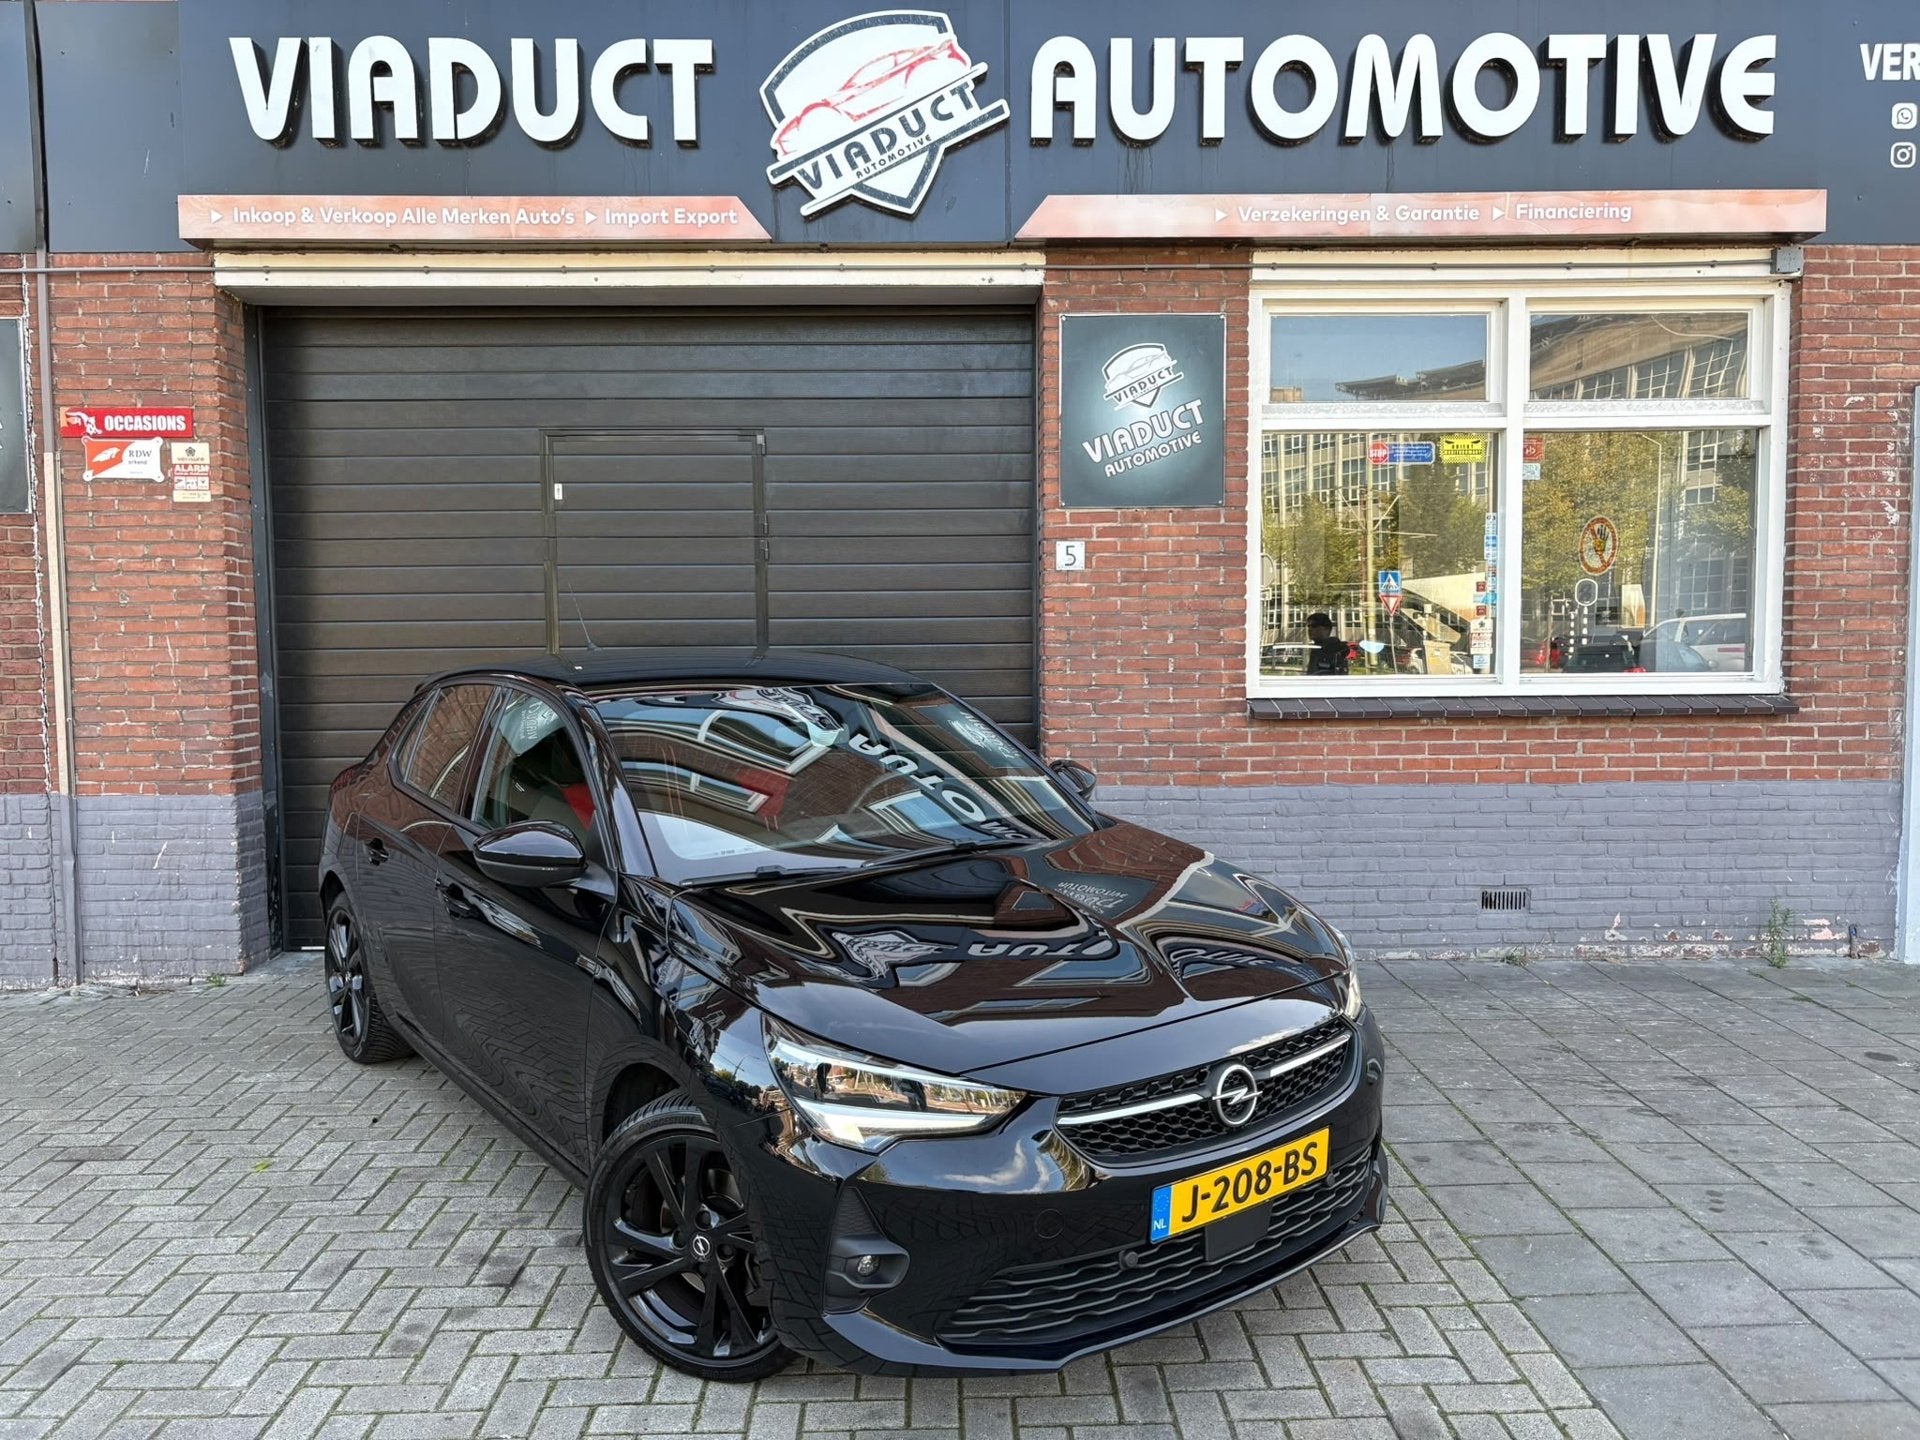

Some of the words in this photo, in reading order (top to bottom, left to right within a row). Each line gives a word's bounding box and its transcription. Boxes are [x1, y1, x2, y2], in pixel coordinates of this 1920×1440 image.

[1860, 43, 1920, 81] VER
[229, 36, 713, 142] VIADUCT
[1030, 33, 1777, 141] AUTOMOTIVE
[797, 81, 982, 190] VIADUCT
[855, 134, 932, 178] AUTOMOTIVE
[233, 207, 296, 226] Inkoop
[301, 207, 314, 223] &
[320, 208, 397, 227] Verkoop
[402, 208, 437, 224] Alle
[442, 208, 511, 224] Merken
[515, 208, 575, 225] Auto's
[605, 208, 670, 227] Import
[674, 209, 738, 227] Export
[1238, 206, 1371, 225] Verzekeringen
[1375, 205, 1390, 222] &
[1395, 205, 1480, 221] Garantie
[1516, 202, 1632, 222] Financiering
[1114, 367, 1172, 402] VIADUCT
[104, 415, 186, 431] OCCASIONS
[1082, 399, 1204, 463] VIADUCT
[1104, 430, 1202, 478] AUTOMOTIVE
[1064, 545, 1076, 566] 5
[1182, 1141, 1318, 1223] J-208-BS
[1153, 1218, 1167, 1230] NL
